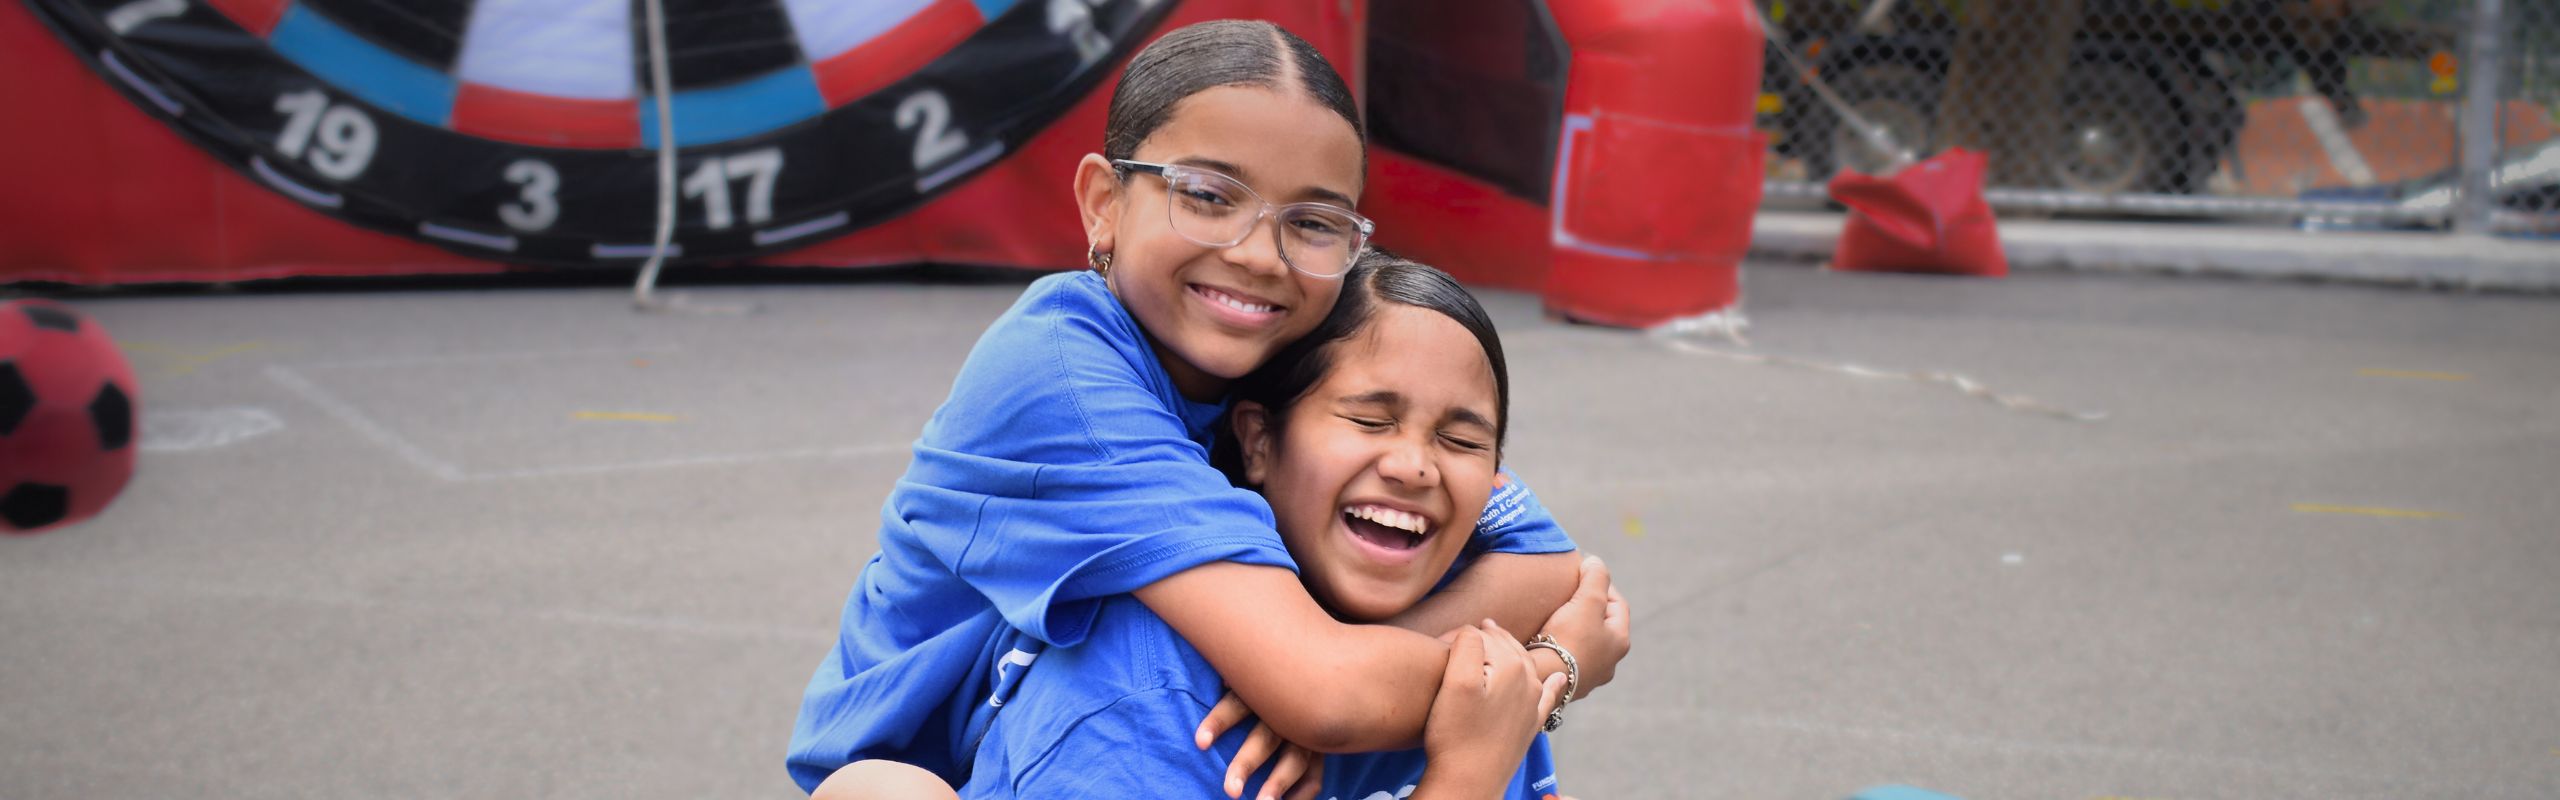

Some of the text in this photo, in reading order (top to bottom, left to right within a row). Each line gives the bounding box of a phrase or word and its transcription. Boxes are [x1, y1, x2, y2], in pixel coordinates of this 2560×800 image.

[273, 89, 378, 181] 19
[895, 90, 969, 170] 2
[499, 160, 560, 231] 3
[683, 148, 784, 230] 17
